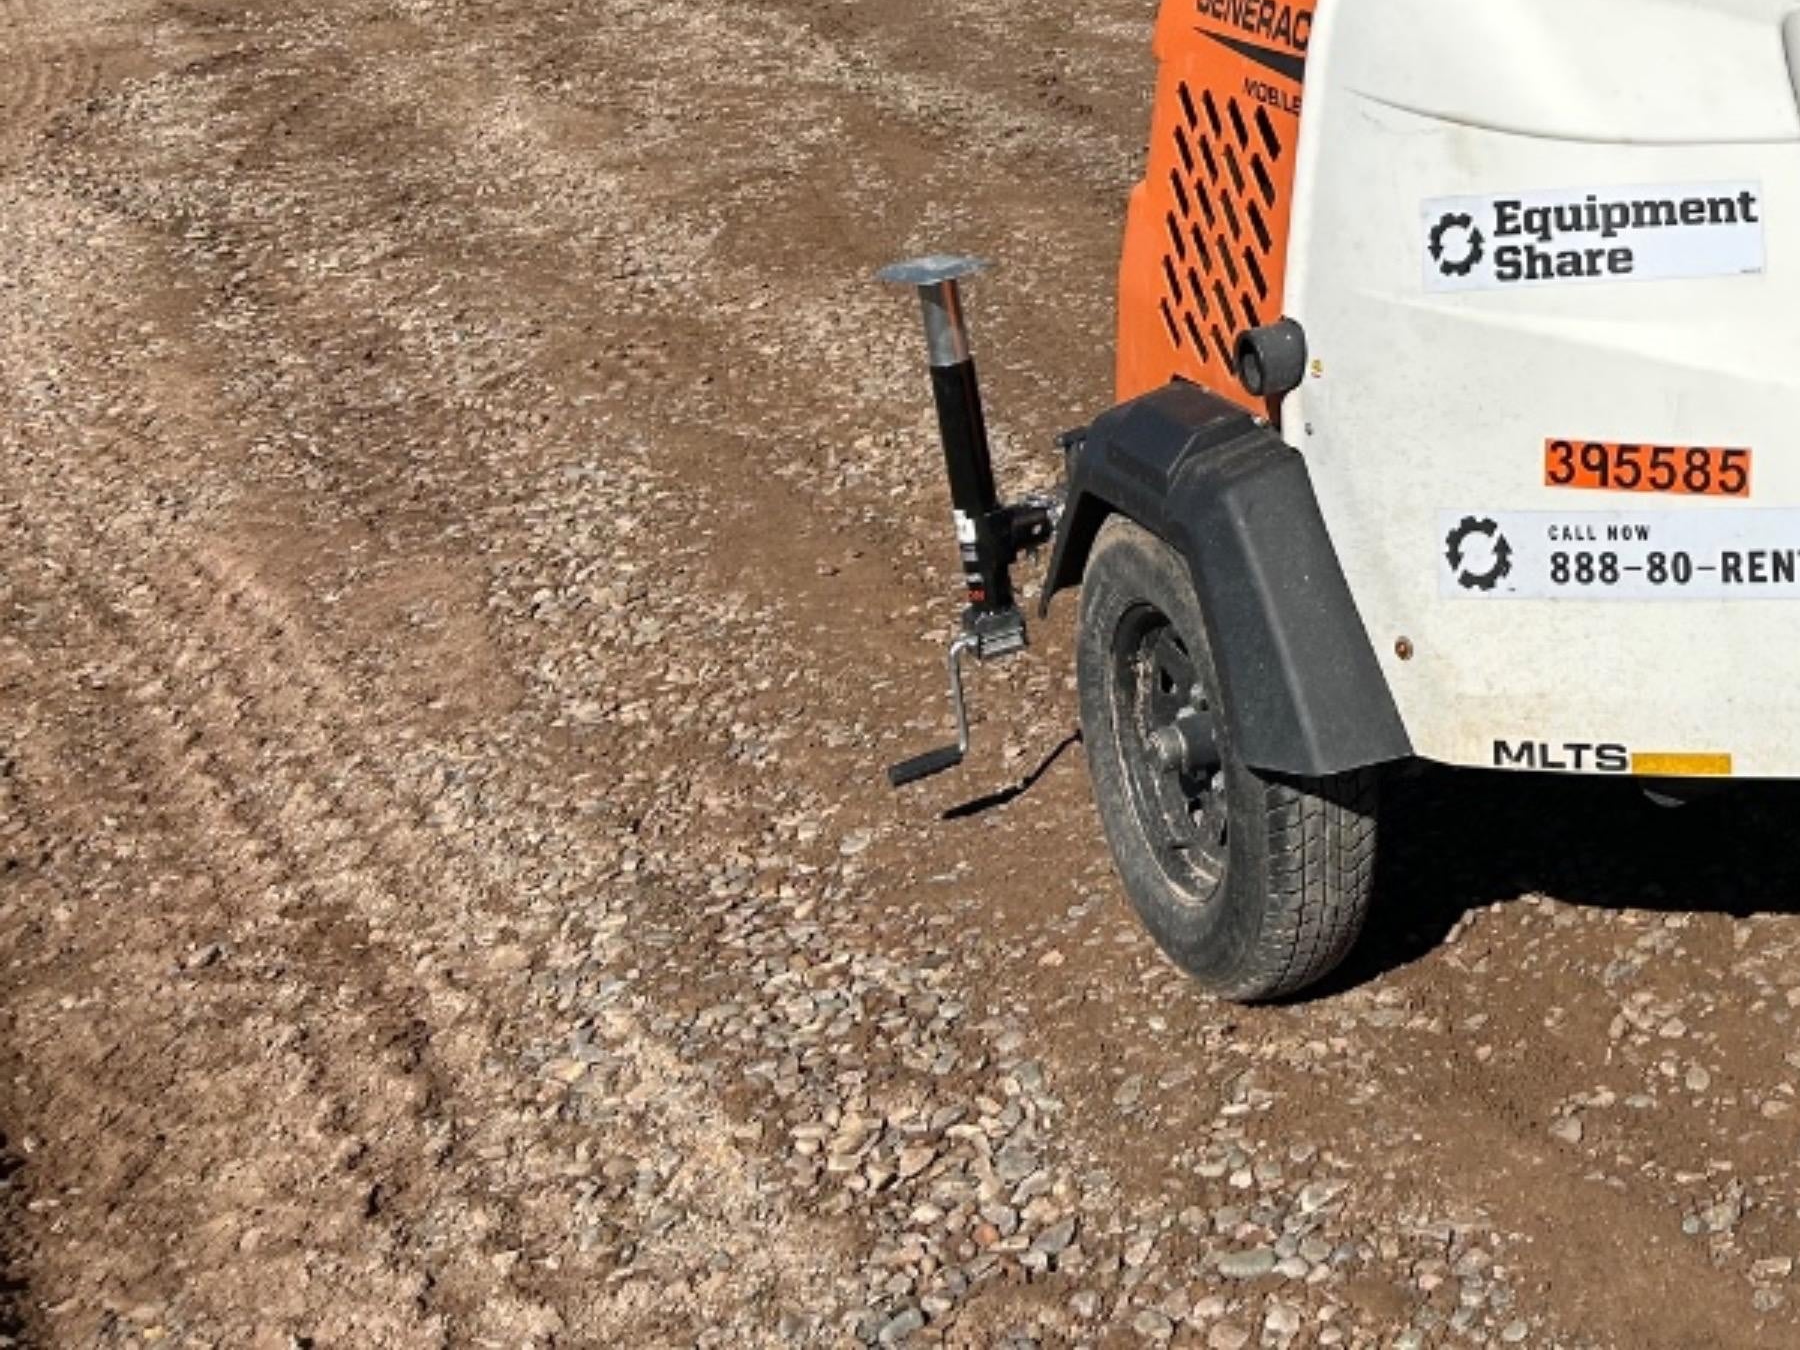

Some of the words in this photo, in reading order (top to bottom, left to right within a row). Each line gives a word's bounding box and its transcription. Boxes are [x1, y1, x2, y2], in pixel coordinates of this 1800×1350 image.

[1493, 190, 1759, 242] Equipment
[1493, 244, 1634, 282] Share
[1547, 439, 1748, 494] 395585
[1547, 524, 1598, 542] CALL
[1606, 524, 1651, 542] NOW
[1493, 740, 1629, 772] MLTS
